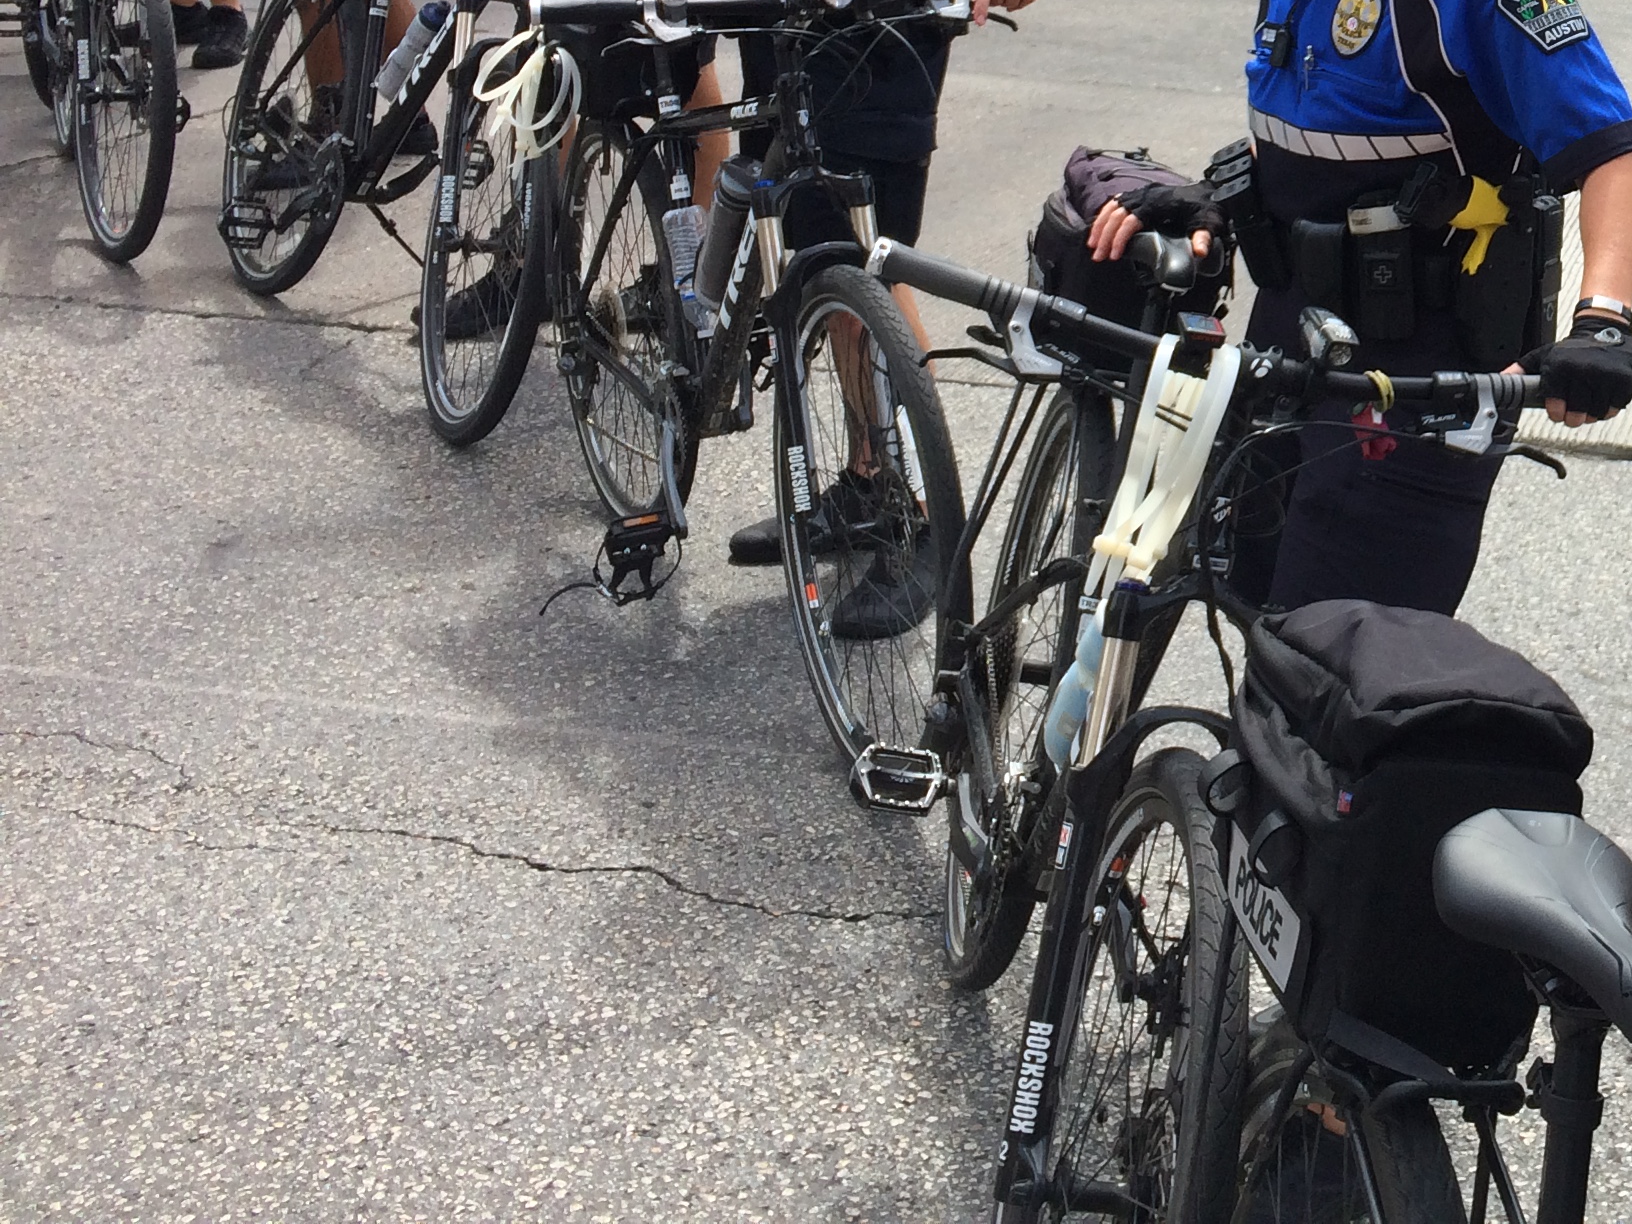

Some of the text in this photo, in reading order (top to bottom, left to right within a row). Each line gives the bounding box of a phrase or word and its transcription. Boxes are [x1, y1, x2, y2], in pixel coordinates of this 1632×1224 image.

[1544, 18, 1585, 44] AUSTIN
[730, 102, 759, 120] POLICE
[439, 175, 456, 223] ROCKSHOX
[787, 445, 812, 513] ROCKSHOX
[1234, 855, 1283, 961] POLICE
[1009, 1020, 1054, 1134] ROCKSHOX
